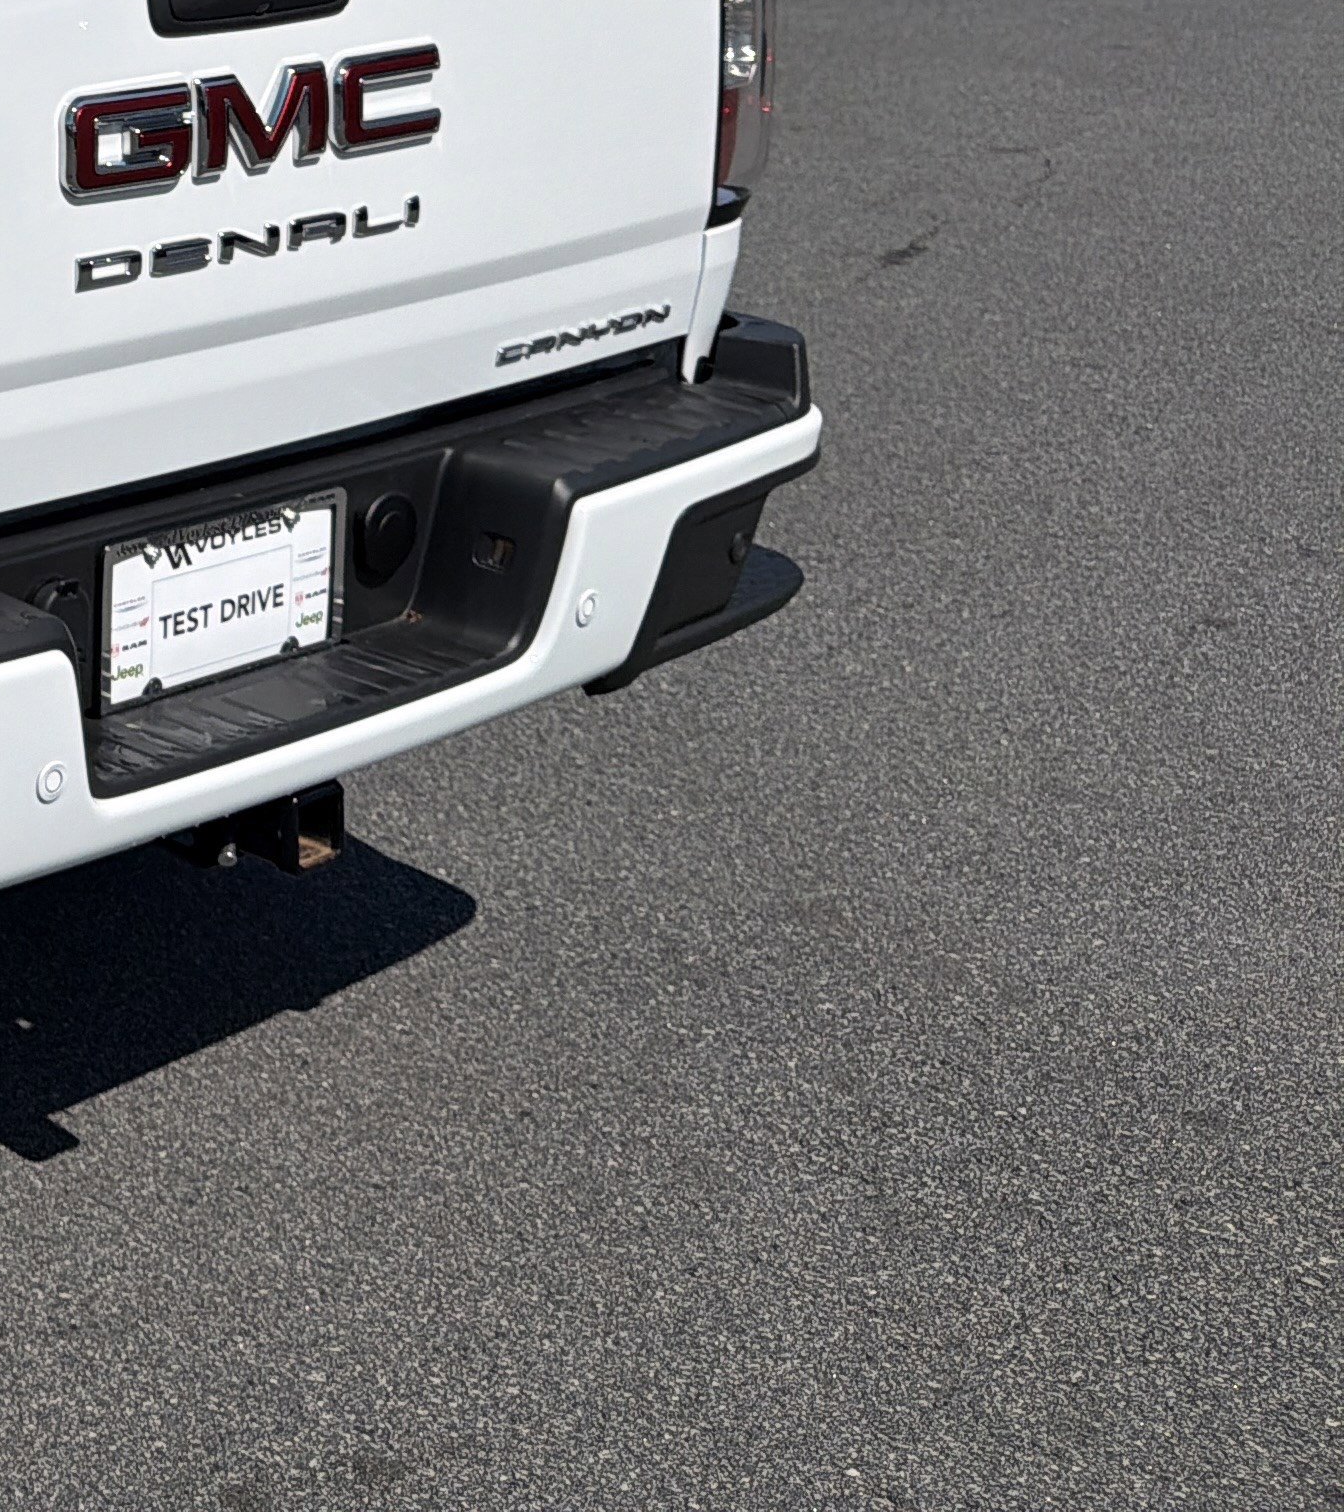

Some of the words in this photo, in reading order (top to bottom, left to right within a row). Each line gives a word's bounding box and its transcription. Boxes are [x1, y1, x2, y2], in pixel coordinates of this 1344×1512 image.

[58, 42, 441, 198] GMC
[74, 194, 421, 294] DENALI
[495, 304, 671, 367] CANYON
[159, 602, 214, 639] TEST
[220, 582, 285, 623] DRIVE
[295, 610, 324, 628] Jeep
[111, 662, 144, 681] Jeep
